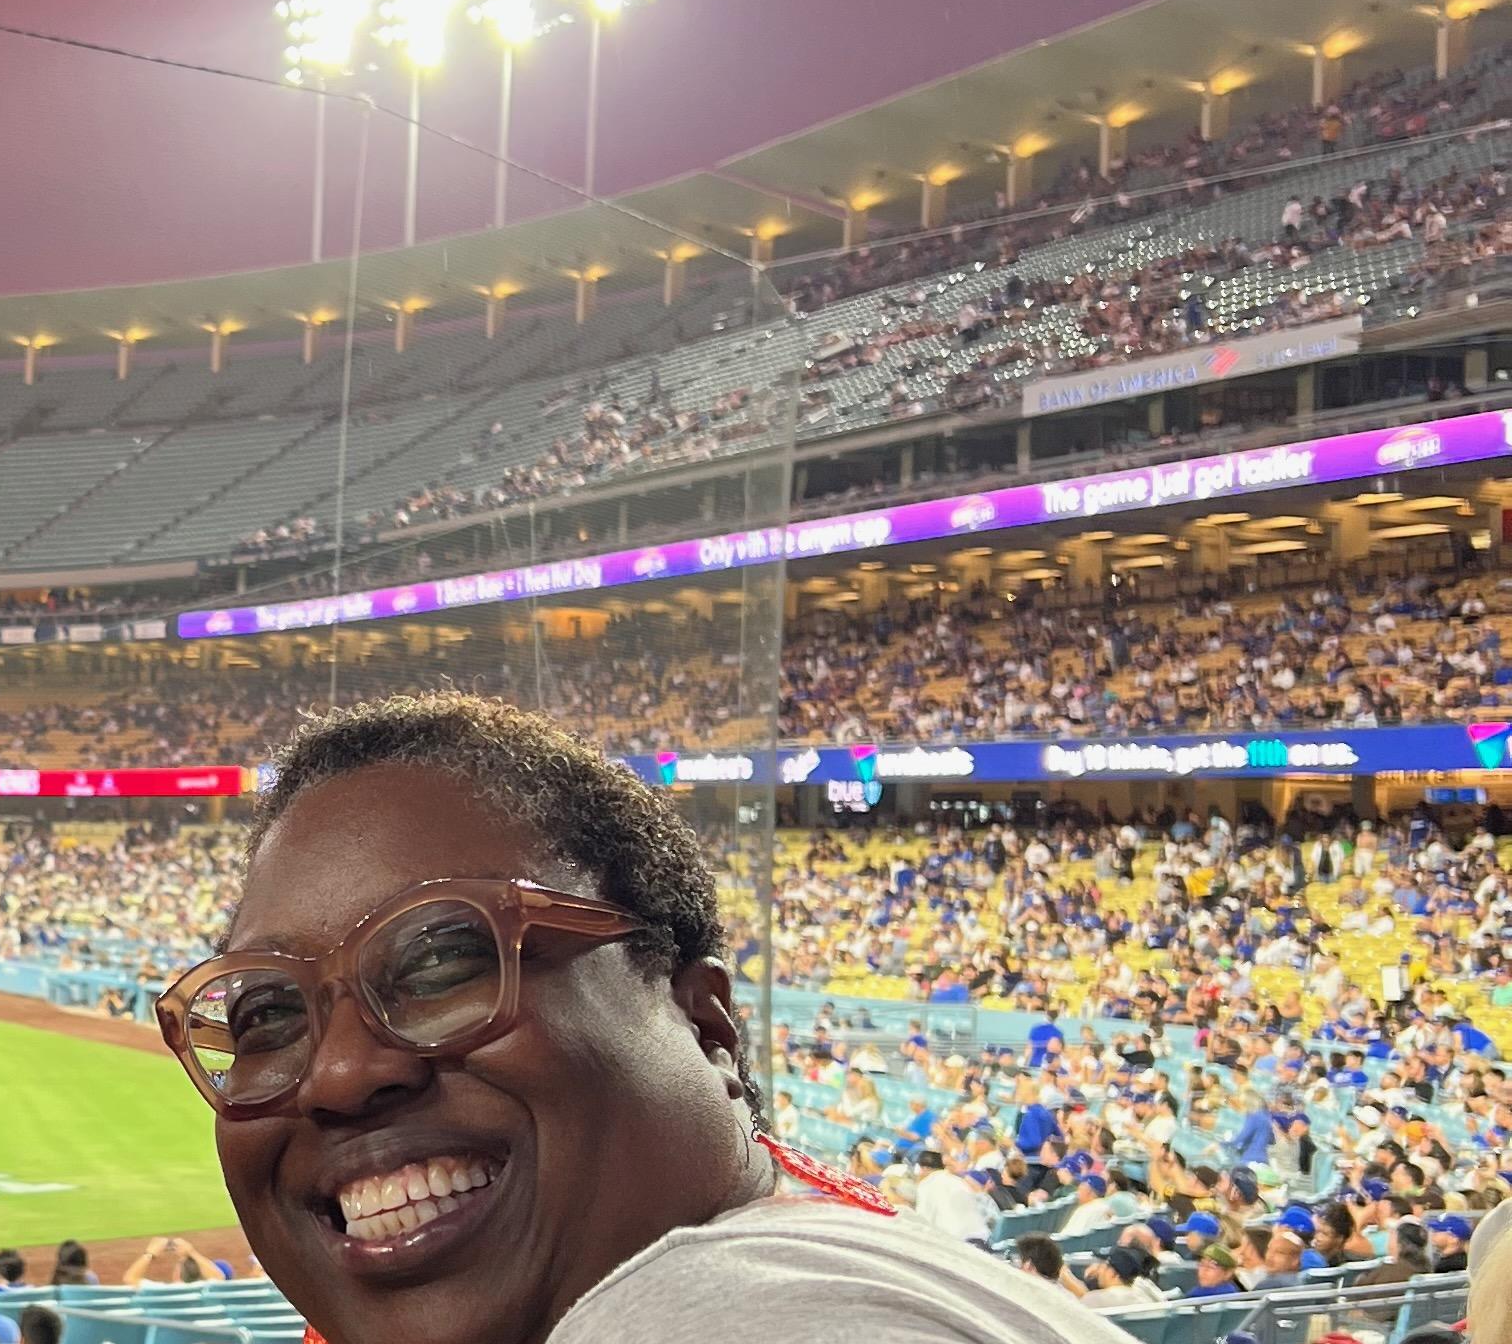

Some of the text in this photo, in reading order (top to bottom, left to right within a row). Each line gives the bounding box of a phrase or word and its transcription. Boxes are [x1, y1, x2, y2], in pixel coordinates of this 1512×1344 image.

[1039, 367, 1197, 411] BANK OF AMERICA
[1043, 449, 1312, 515] The game just got tastier
[700, 537, 733, 567] Only
